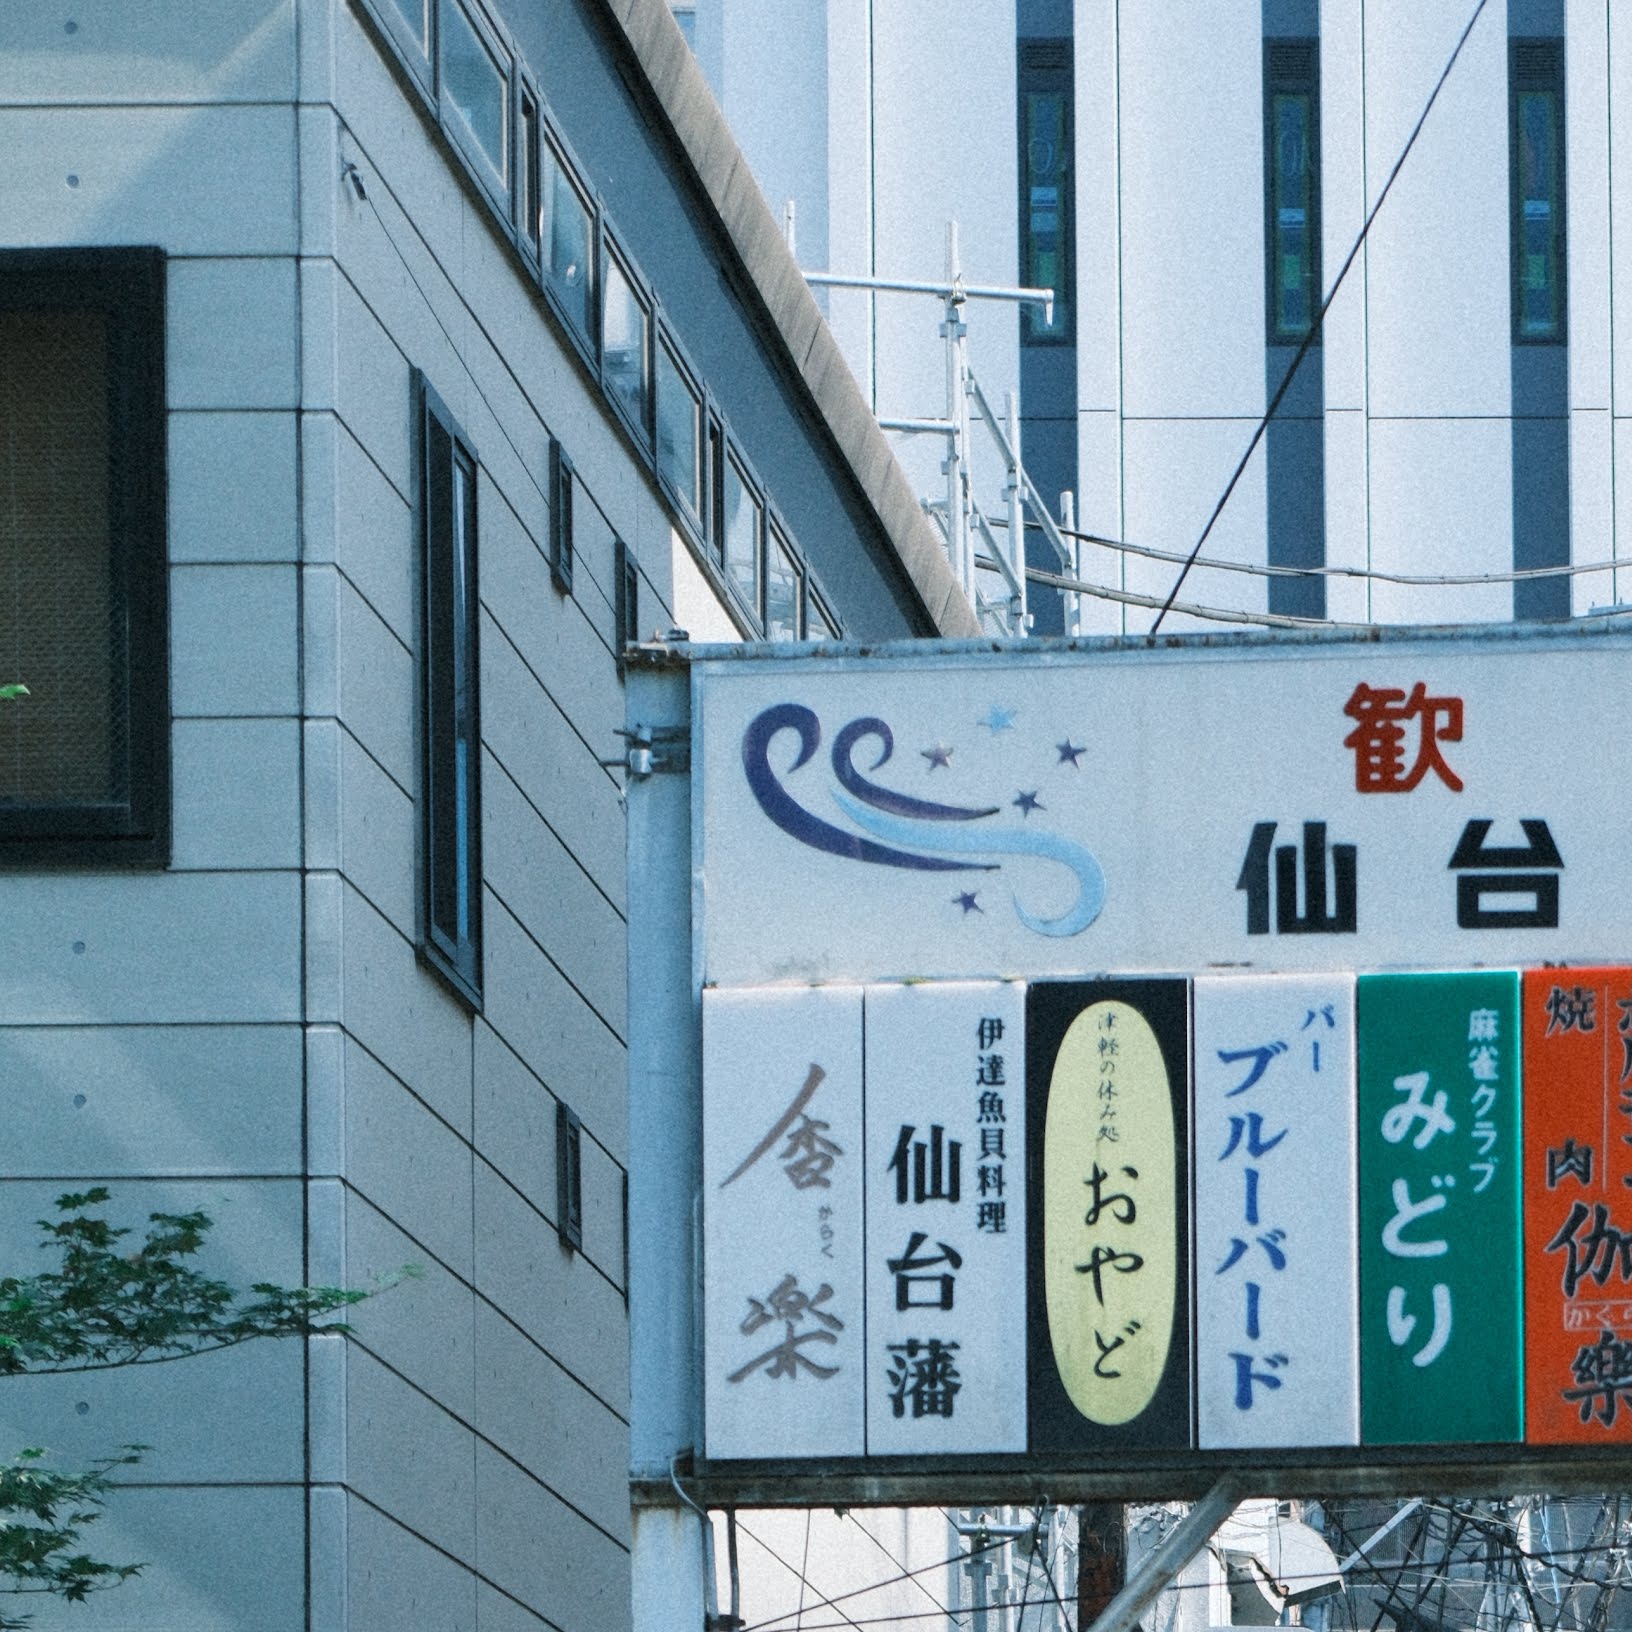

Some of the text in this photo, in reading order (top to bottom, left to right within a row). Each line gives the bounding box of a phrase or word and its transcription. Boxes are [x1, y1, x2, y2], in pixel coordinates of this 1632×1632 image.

[975, 1016, 1007, 1235] 伊達魚貝料理
[1096, 1011, 1120, 1144] 津軽の休み処
[1301, 1003, 1335, 1073] バー
[1468, 1008, 1500, 1194] 麻雀クラブ
[1545, 985, 1596, 1190] 焼肉
[886, 1124, 963, 1419] 仙台藩
[1075, 1160, 1144, 1379] おやど
[1215, 1040, 1289, 1411] ブルーバード
[1381, 1071, 1456, 1368] みどり
